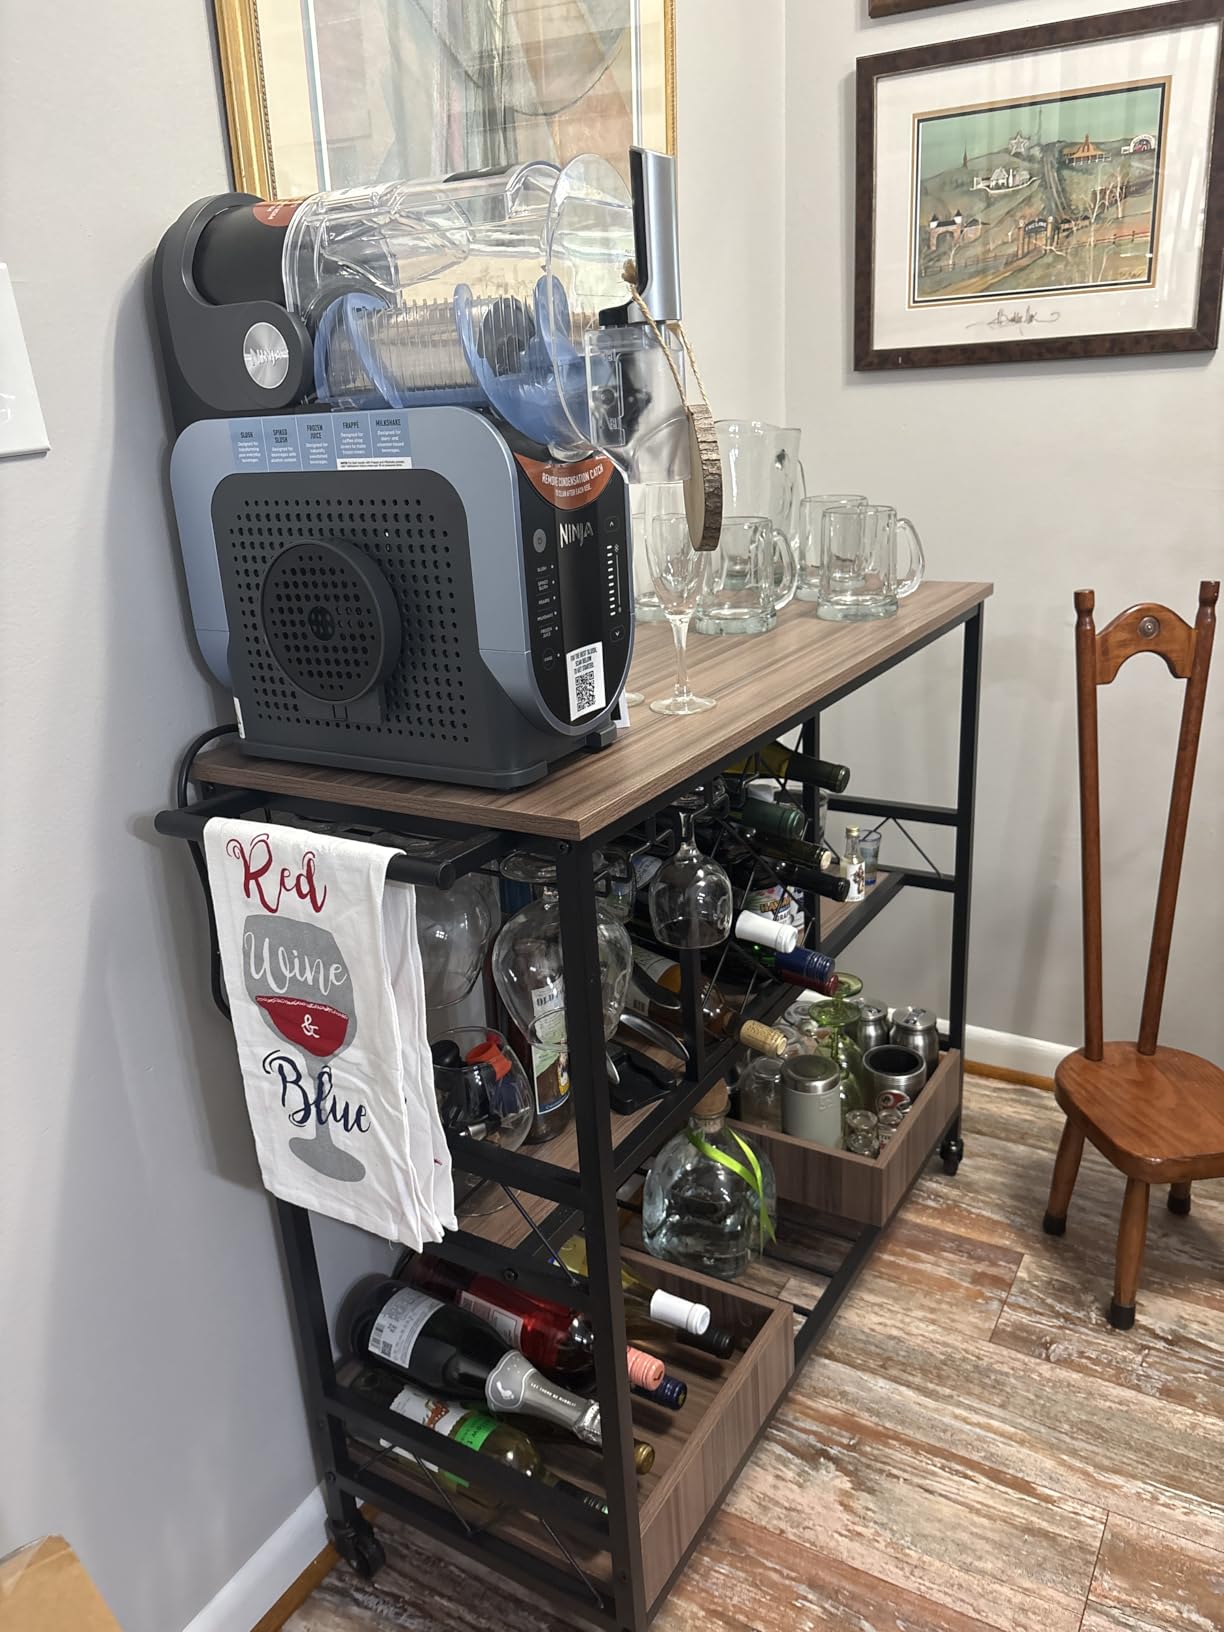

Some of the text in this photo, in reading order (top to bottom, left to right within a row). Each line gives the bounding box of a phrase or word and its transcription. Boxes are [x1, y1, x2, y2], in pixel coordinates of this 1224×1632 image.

[272, 428, 288, 436] SPIKED
[306, 424, 323, 432] FROZEN
[375, 418, 401, 427] MILKSHAKE
[310, 432, 322, 440] JUICE
[541, 463, 604, 487] REMOVE CONDENSATION CATCH
[559, 521, 594, 549] NINJA
[226, 833, 327, 914] Red
[244, 931, 349, 996] Wine
[301, 1014, 320, 1039] &
[262, 1049, 372, 1133] Blue
